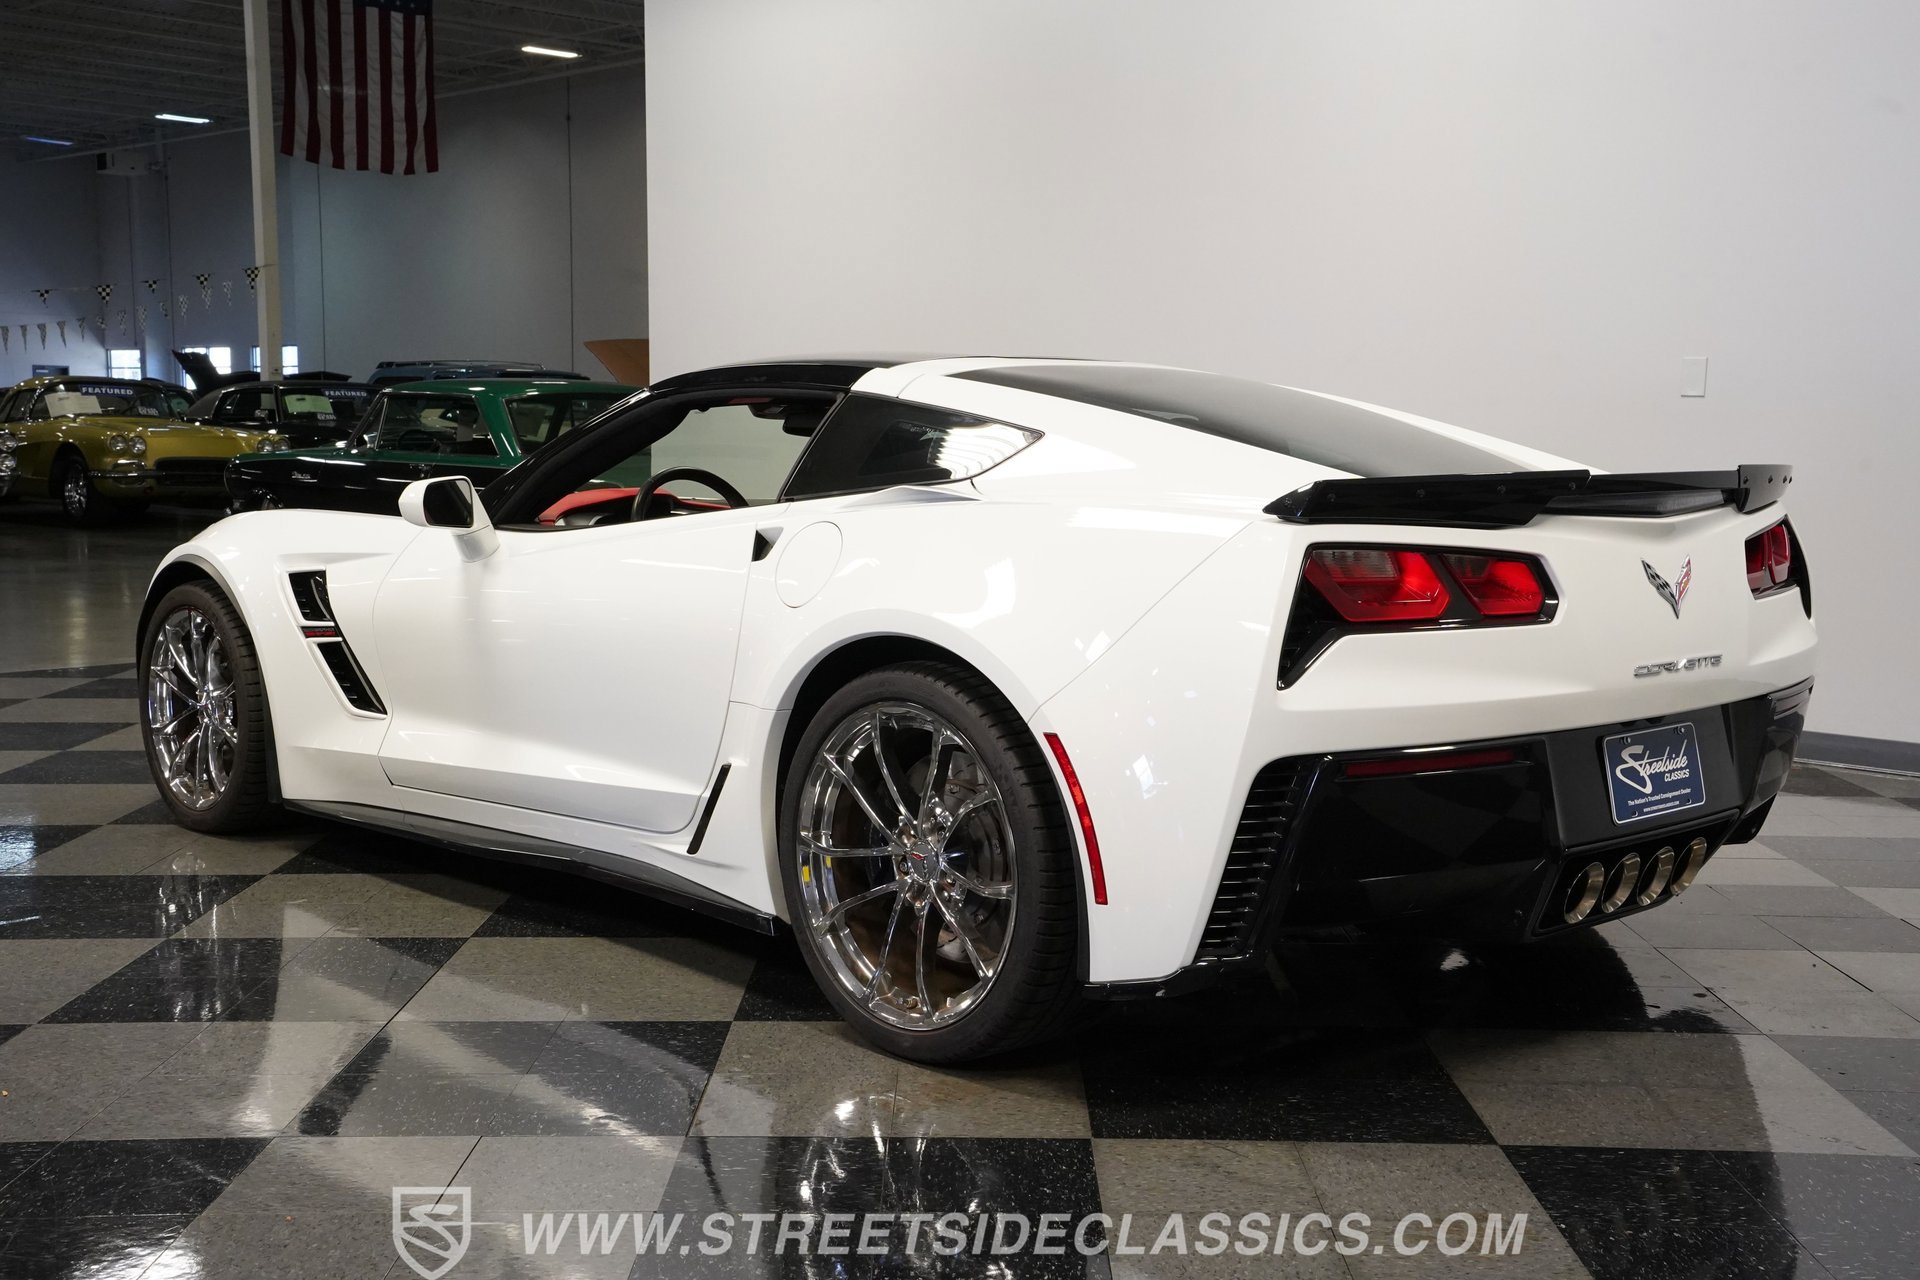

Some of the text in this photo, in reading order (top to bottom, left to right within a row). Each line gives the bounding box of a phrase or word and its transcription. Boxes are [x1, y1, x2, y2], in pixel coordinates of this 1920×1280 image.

[82, 387, 134, 396] FEATURED
[1633, 654, 1723, 677] CORVETTE
[1615, 739, 1688, 794] Streetside
[1664, 769, 1690, 782] CLASSICS
